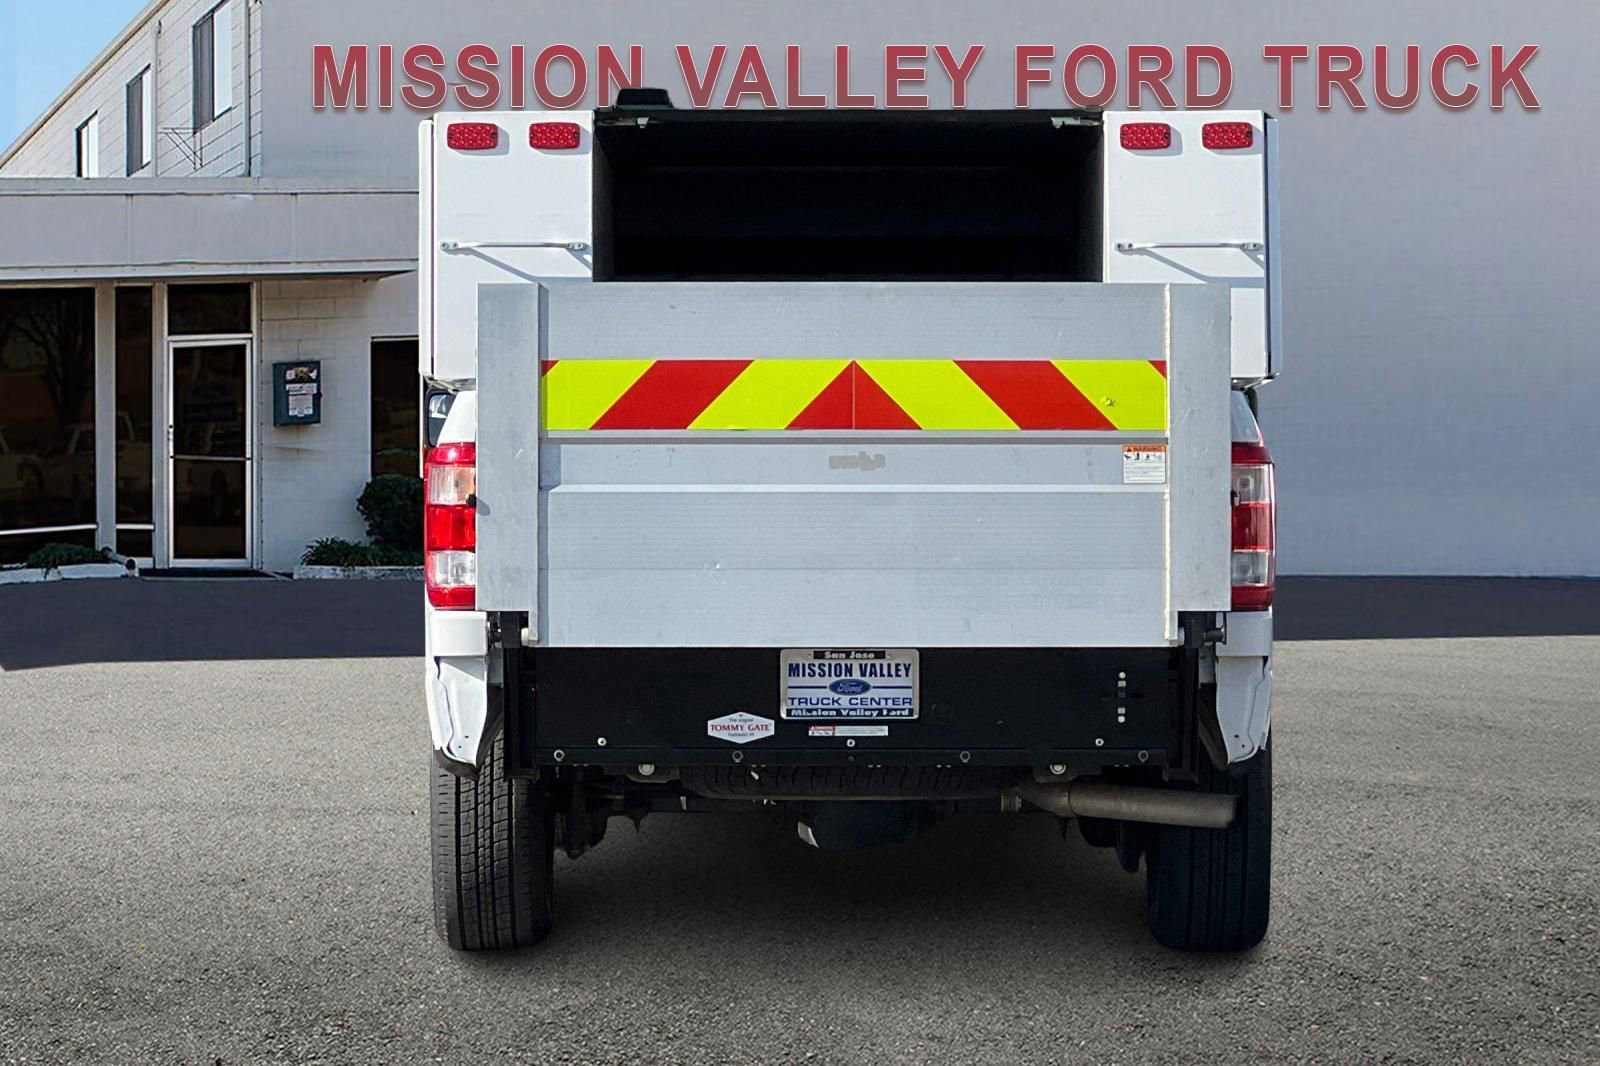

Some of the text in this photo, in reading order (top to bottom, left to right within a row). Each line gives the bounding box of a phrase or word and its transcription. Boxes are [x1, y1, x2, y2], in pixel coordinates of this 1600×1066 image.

[311, 44, 1541, 110] MISSION VALLEY FORD TRUCK
[824, 650, 846, 659] San
[788, 662, 912, 678] MISSION VALLEY
[836, 681, 863, 693] Ford
[788, 697, 912, 706] TRUCK CENTER
[840, 709, 879, 718] Valley
[710, 724, 769, 732] TOMMY GATE
